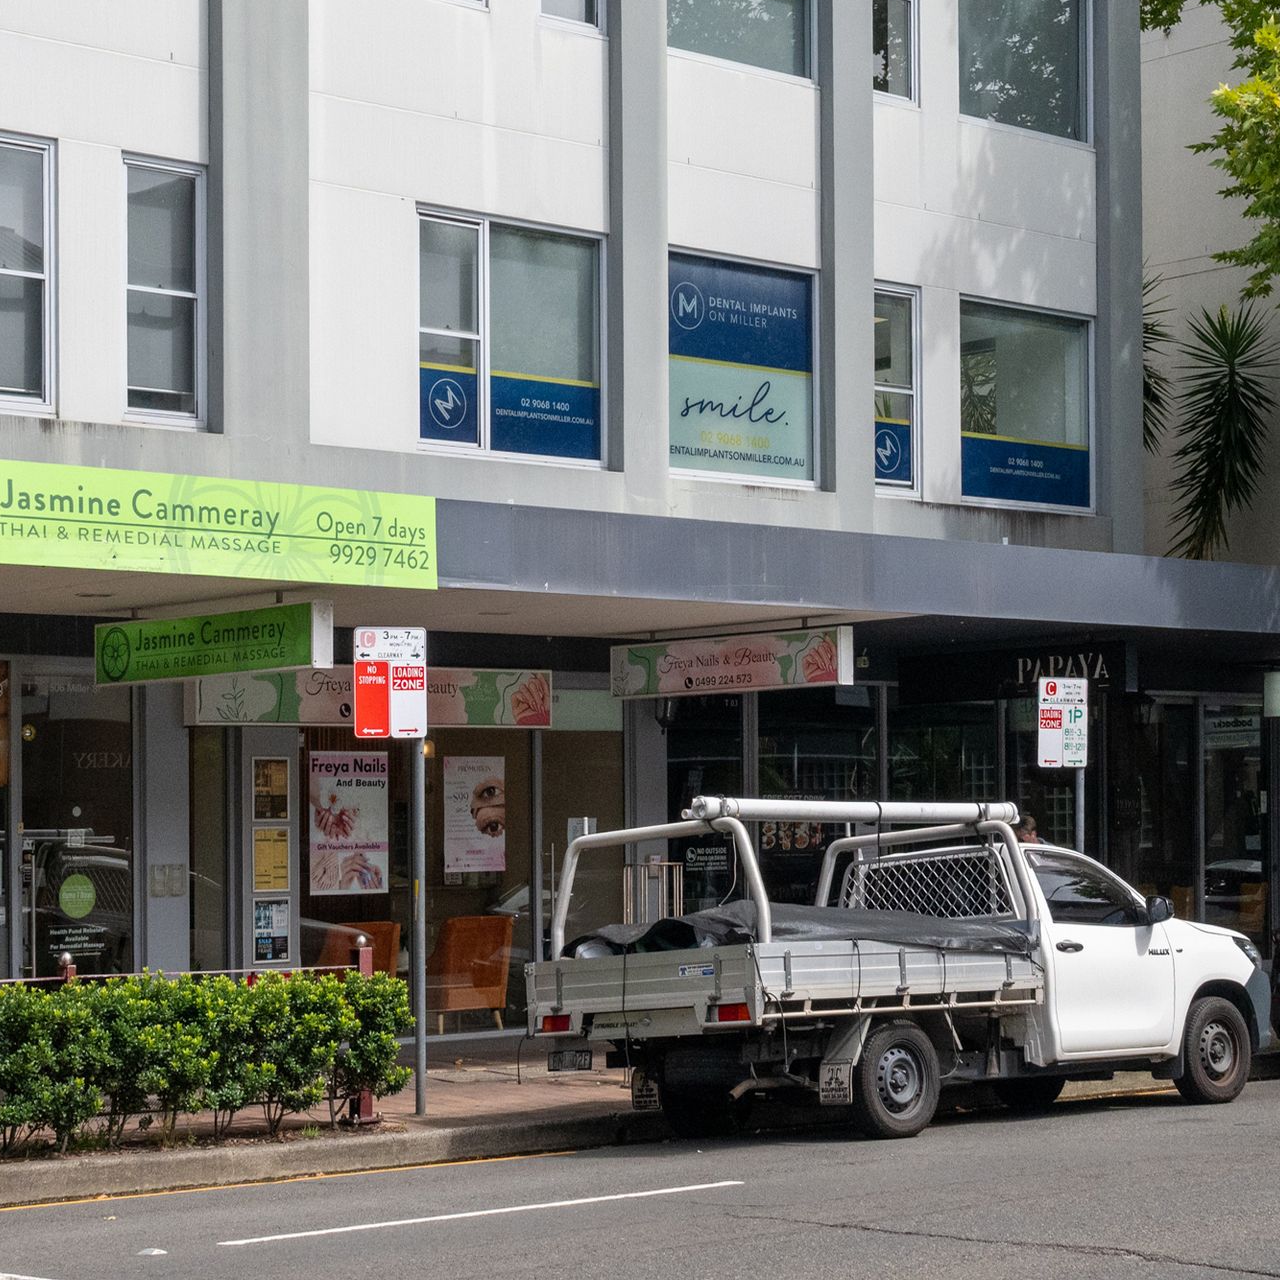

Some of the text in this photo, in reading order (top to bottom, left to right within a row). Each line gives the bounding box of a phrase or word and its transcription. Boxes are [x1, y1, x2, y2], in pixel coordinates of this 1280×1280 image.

[709, 297, 797, 320] DENTAL IMPLANTS
[709, 311, 768, 329] ON MILLER
[520, 397, 570, 412] 02 9068 1400
[700, 431, 713, 443] 02
[669, 444, 805, 467] ENTALIMPLANTSONMILLER.COM.AU
[0, 478, 280, 539] Jasmine Cammeray
[316, 511, 426, 545] Open 7 days
[57, 526, 70, 540] &
[78, 527, 183, 548] REMEDIAL
[191, 534, 281, 555] MASSAGE
[329, 543, 429, 570] 9929 7462
[135, 619, 286, 652] Jasmine Cammeray
[135, 645, 286, 671] THAI & REMEDIAL MASSAGE
[661, 647, 778, 674] Freya Nails & Beauty
[367, 665, 377, 674] NO
[393, 667, 423, 678] LOADING
[305, 671, 352, 697] Freya
[426, 675, 459, 698] eauty
[358, 676, 386, 685] STOPPING
[393, 679, 423, 690] ZONE
[695, 674, 752, 686] 0499 224 573
[1040, 710, 1062, 718] LOADING
[1068, 709, 1083, 723] 1P
[1040, 720, 1062, 728] ZONE
[312, 758, 387, 776] Freya Nails
[336, 779, 386, 789] And Beauty
[50, 928, 68, 936] Health
[65, 935, 90, 943] Available
